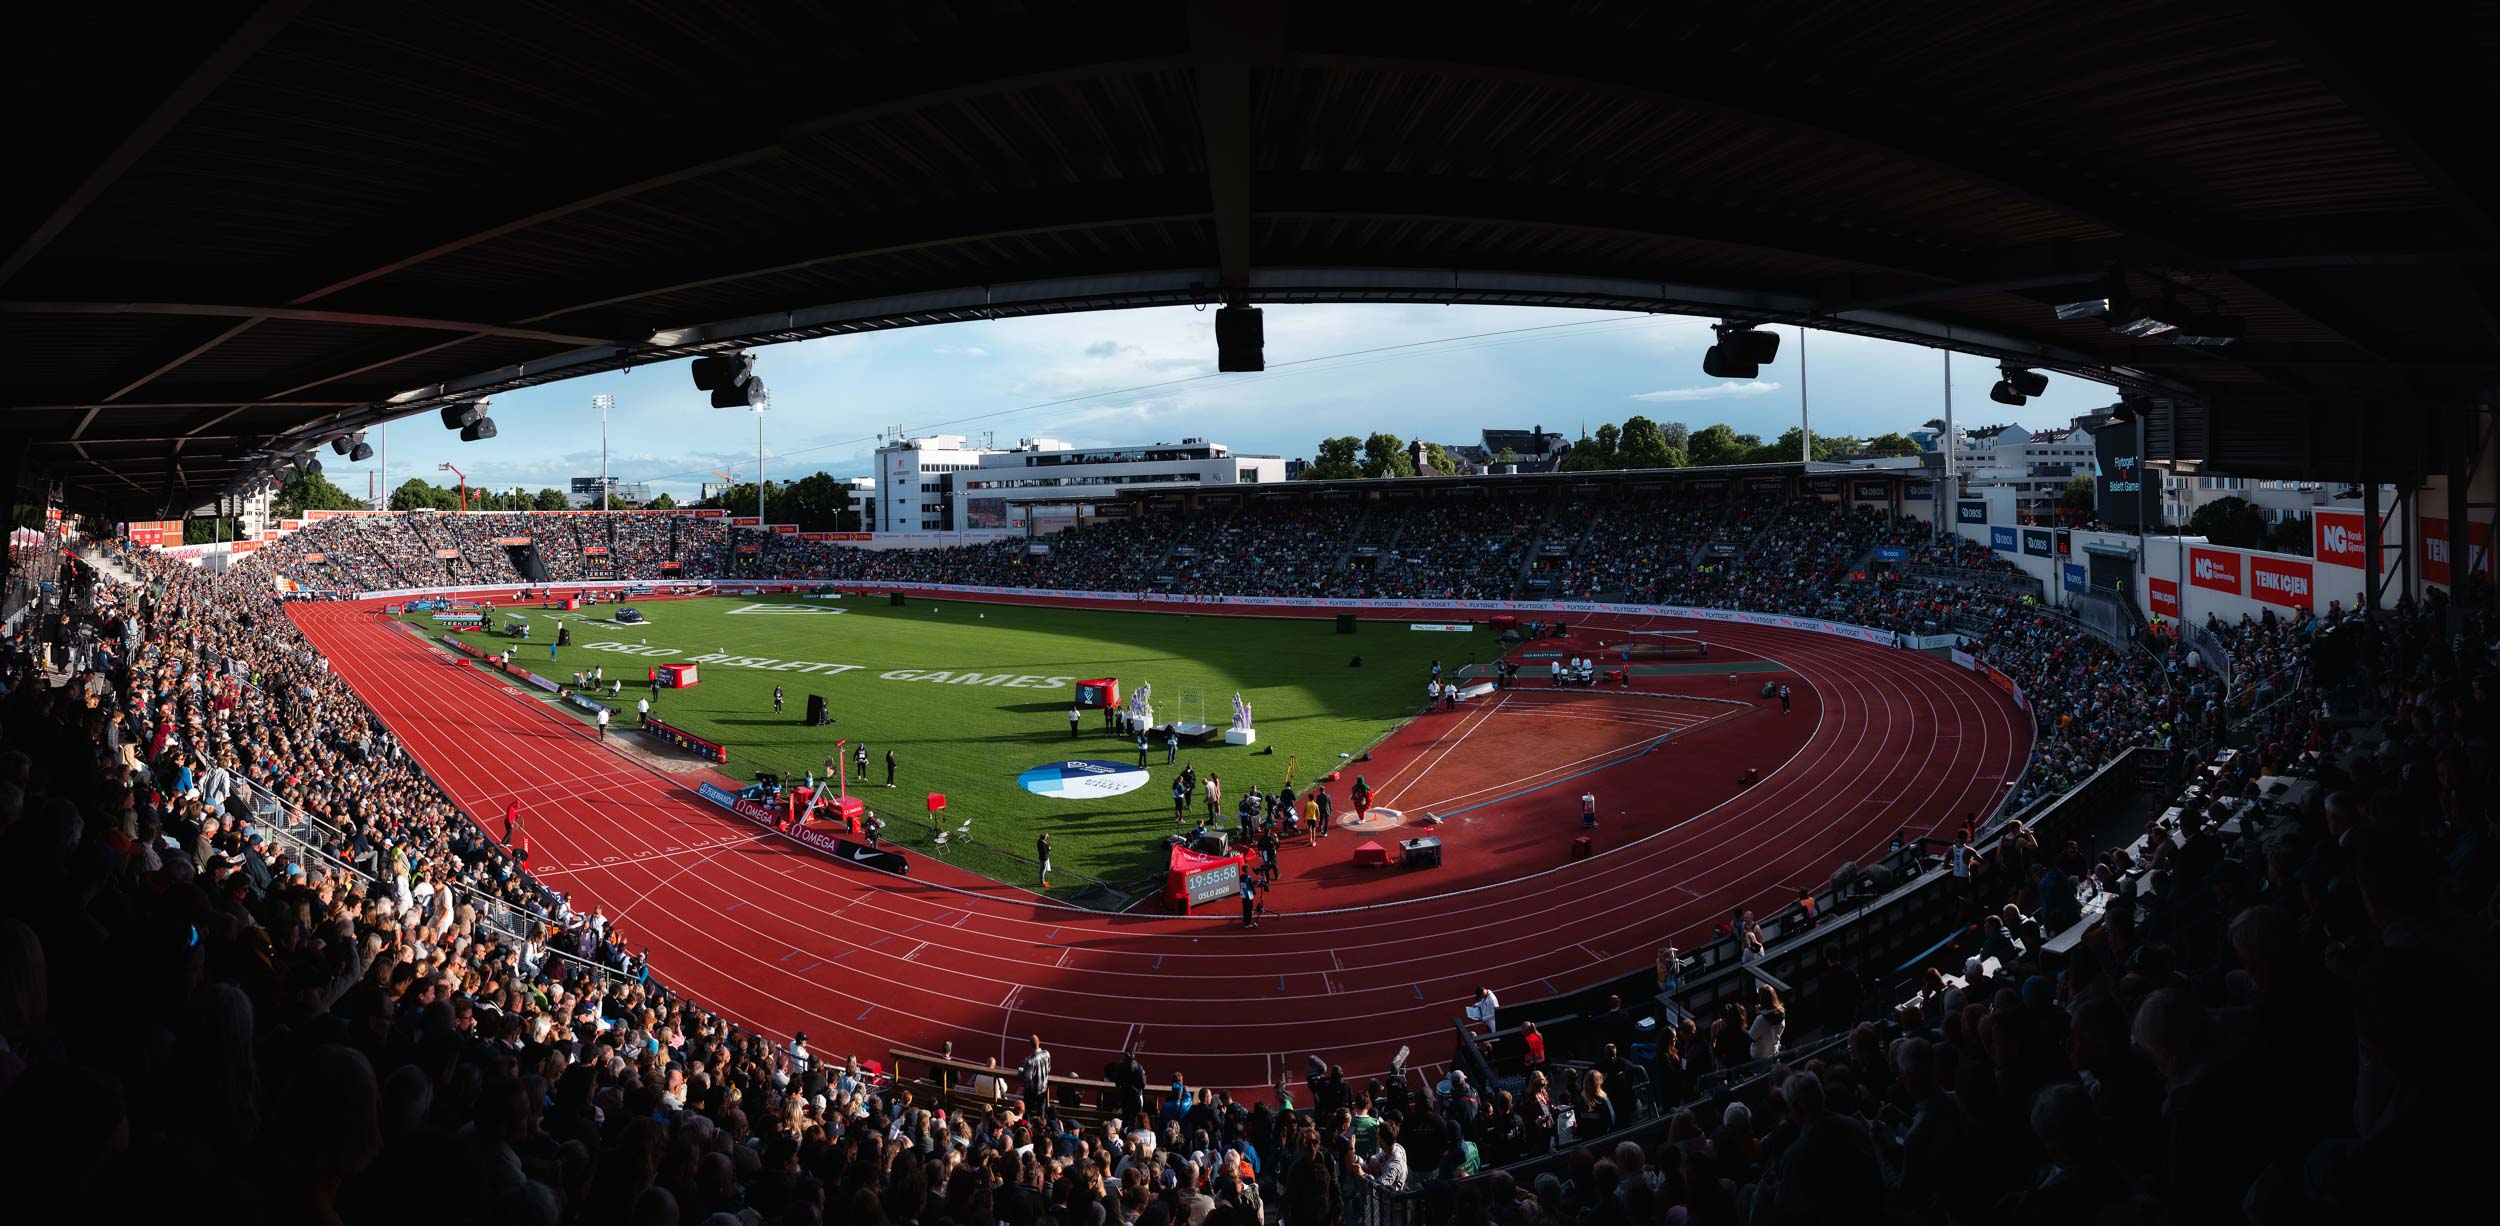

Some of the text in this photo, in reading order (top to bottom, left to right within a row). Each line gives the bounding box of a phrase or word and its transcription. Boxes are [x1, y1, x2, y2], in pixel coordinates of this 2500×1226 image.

[2114, 455, 2135, 470] Flytoget
[1869, 487, 1885, 496] OBOS
[2109, 481, 2140, 492] Bislett Game
[1968, 508, 1982, 518] OBOS
[2000, 535, 2013, 545] OBOS
[2033, 539, 2047, 550] OBOS
[2323, 524, 2347, 554] NG
[2425, 537, 2450, 563] TEN
[2194, 557, 2213, 580] NG
[2255, 570, 2308, 598] TENK IGJEN
[1705, 612, 1733, 620] FLYTOGET
[1750, 616, 1776, 624] FLYTOGET
[1793, 621, 1819, 630] FLYTOGET
[1835, 627, 1860, 637] FLYTOGET
[581, 641, 1076, 689] OSLO BISLETT GAMES
[745, 805, 773, 825] OMEGA
[848, 806, 862, 814] OMEGA
[692, 840, 711, 848] 3
[801, 829, 836, 851] OMEGA
[633, 850, 653, 858] 5
[537, 865, 556, 873] 8
[1189, 866, 1237, 890] 19:55:58
[1198, 885, 1230, 900] OSLO 2026
